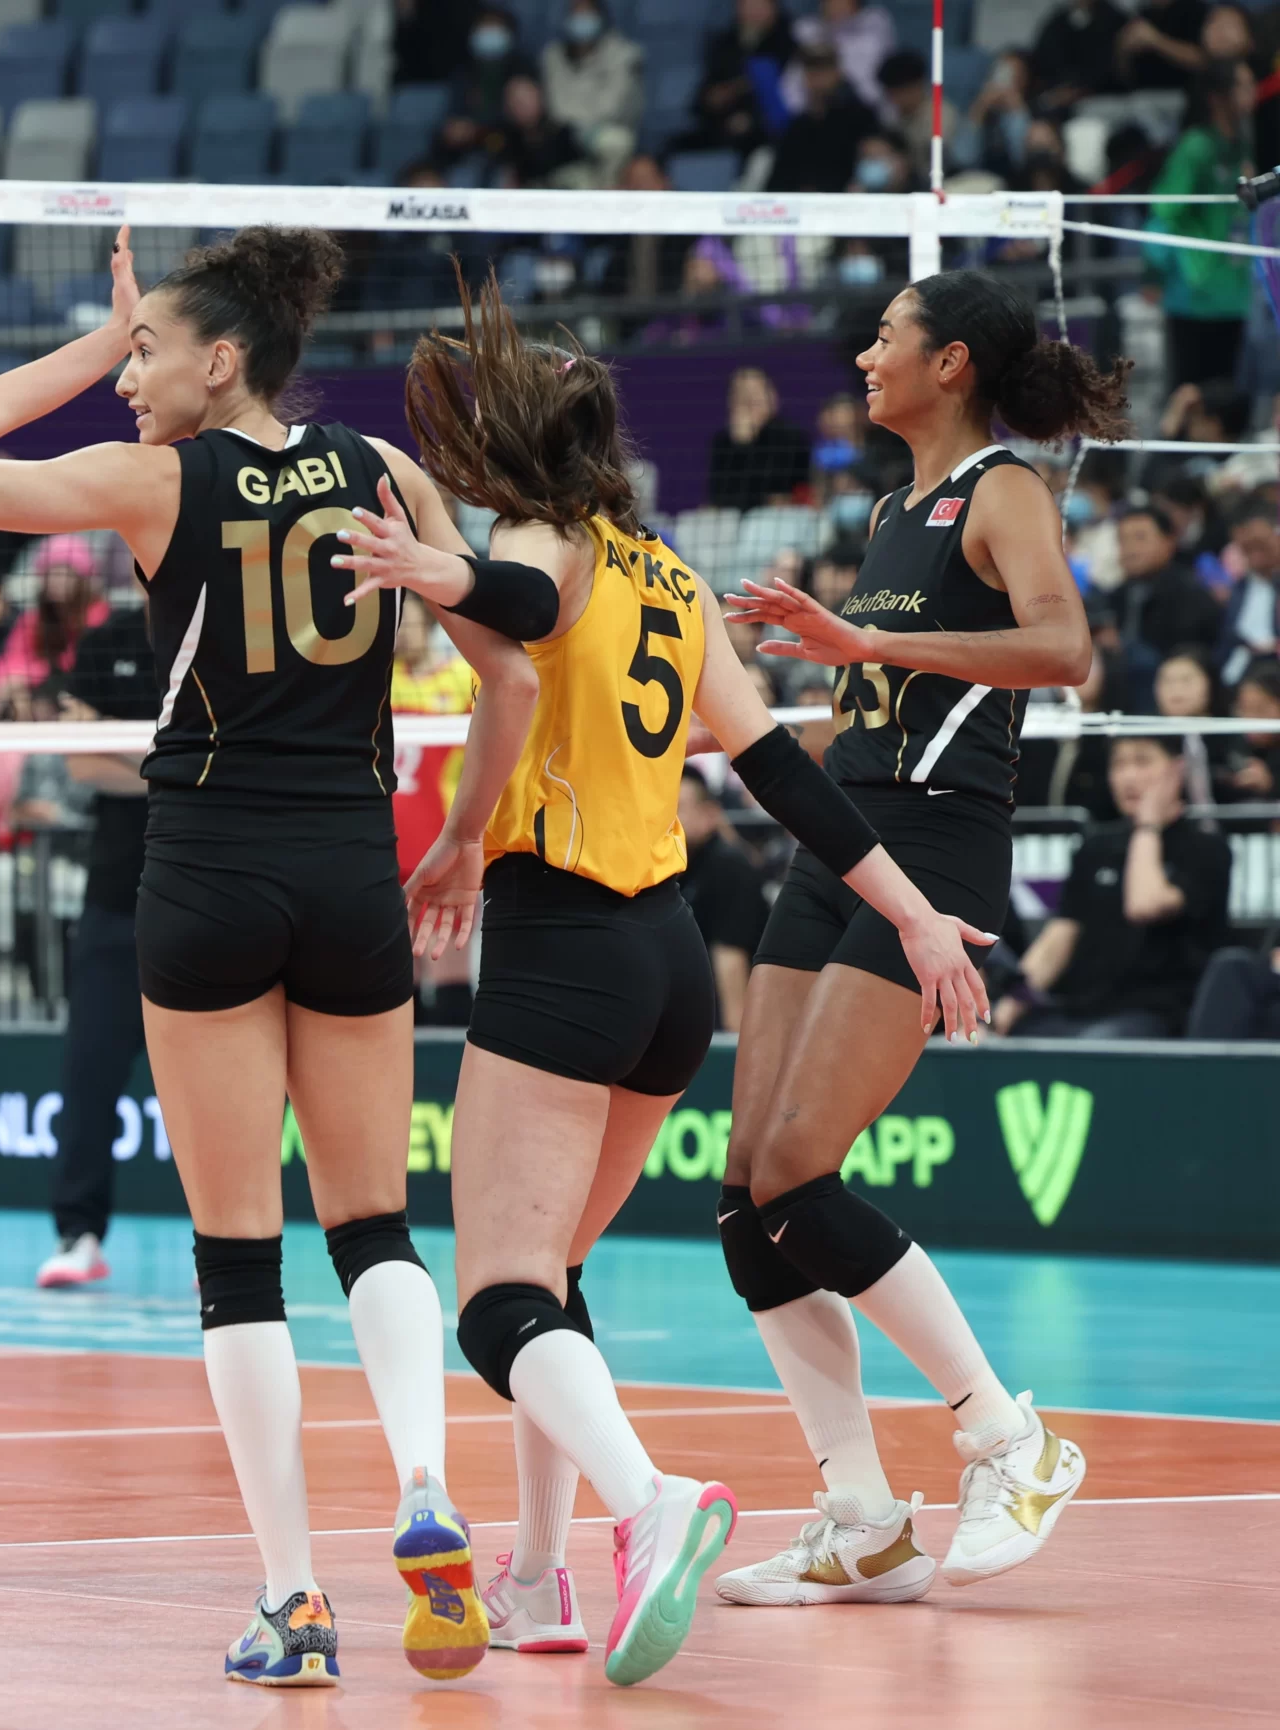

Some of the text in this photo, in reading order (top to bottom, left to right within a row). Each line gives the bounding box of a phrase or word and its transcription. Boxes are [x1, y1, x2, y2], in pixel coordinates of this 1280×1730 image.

[236, 450, 348, 505] GABI
[221, 506, 381, 675] 10
[621, 603, 684, 759] 5
[840, 1114, 956, 1188] APP
